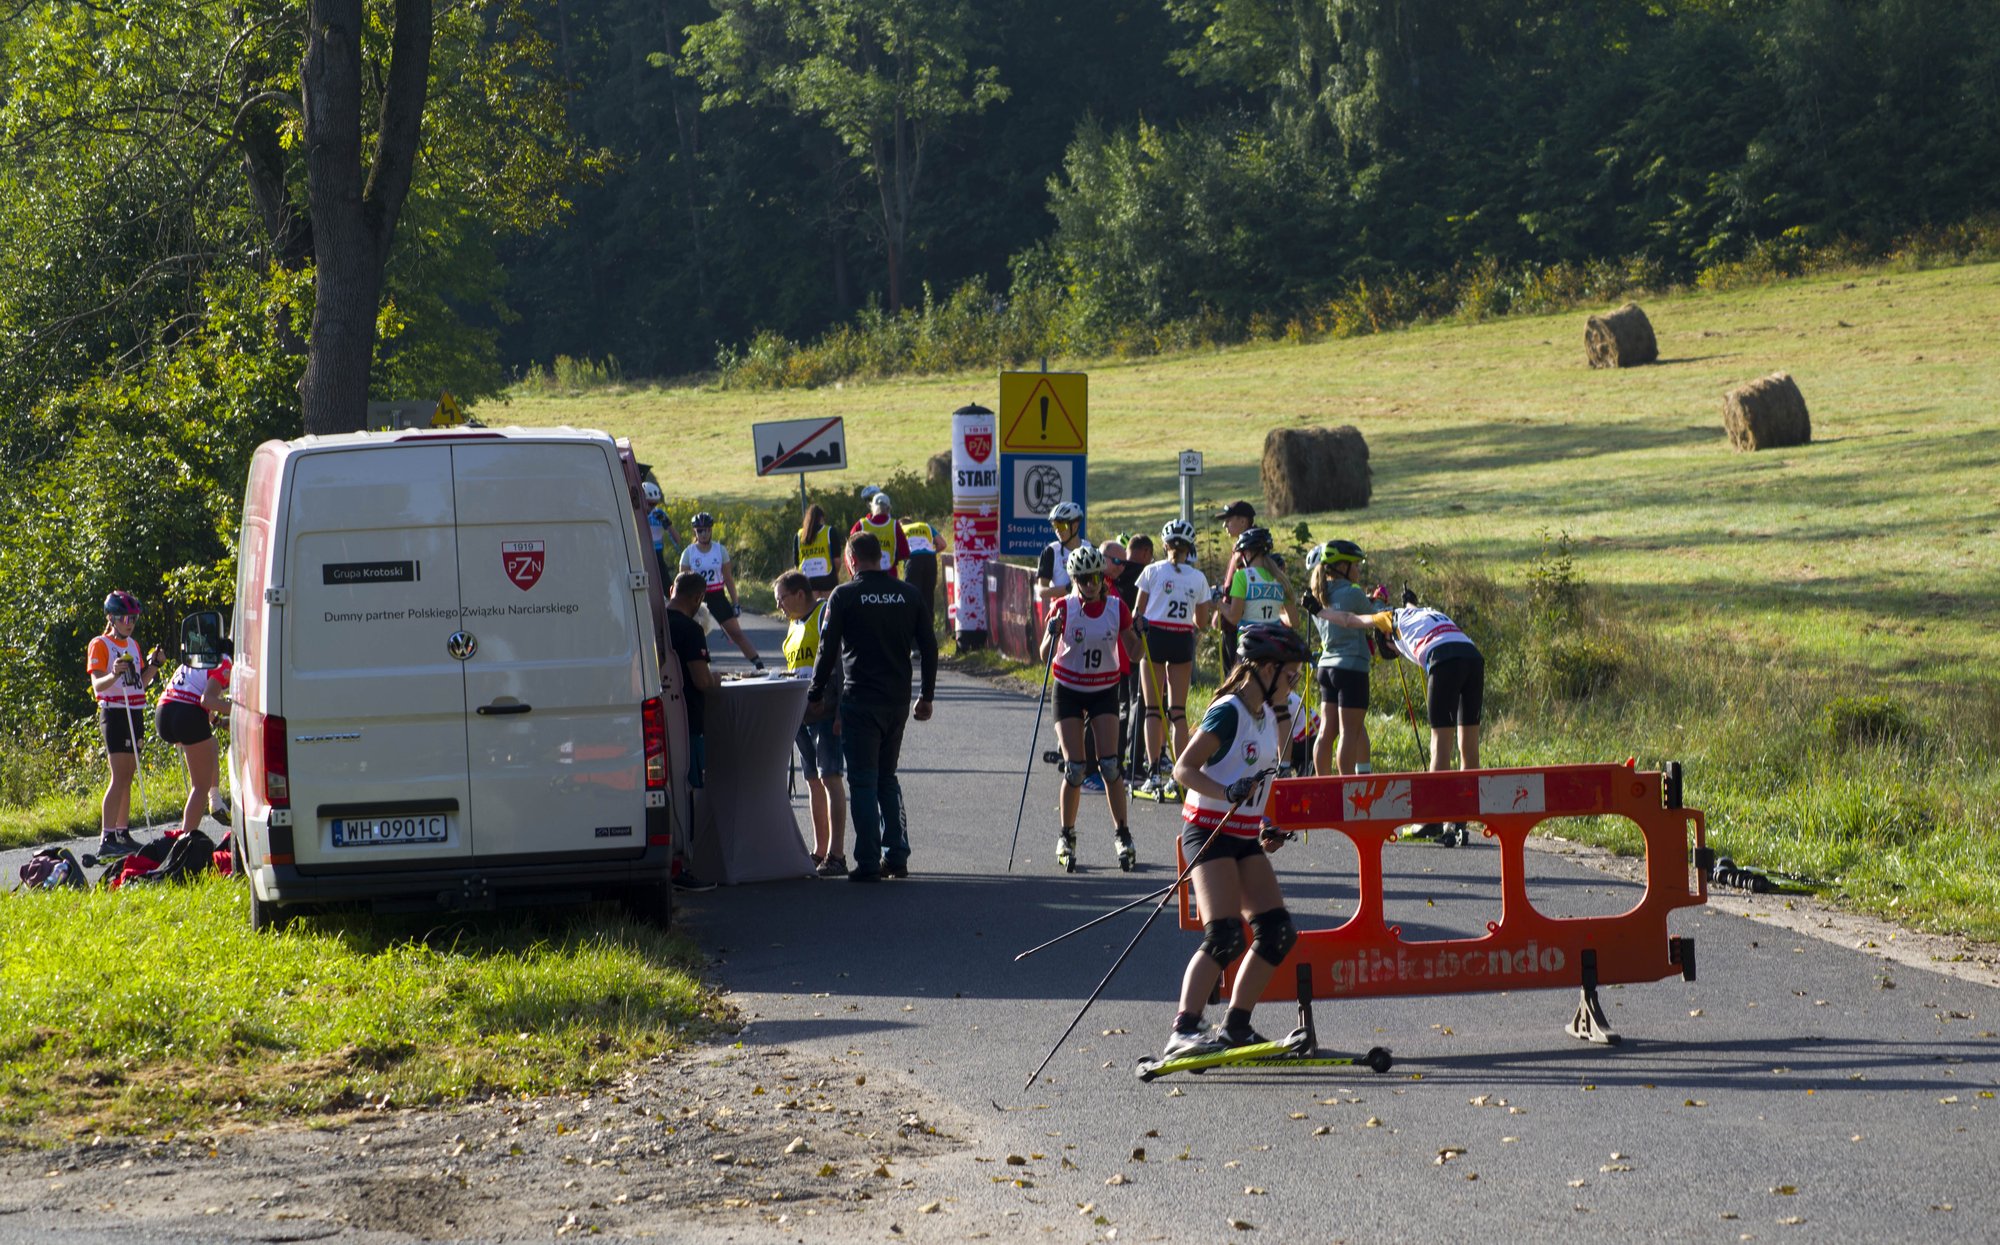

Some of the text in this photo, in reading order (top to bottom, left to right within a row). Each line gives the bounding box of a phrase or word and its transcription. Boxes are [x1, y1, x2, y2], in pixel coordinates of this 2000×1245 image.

[969, 437, 990, 456] PZN
[958, 470, 996, 487] START
[1007, 523, 1036, 535] Stosuj
[513, 543, 534, 551] 1919
[334, 567, 403, 579] Grupa Krotoski
[508, 557, 542, 580] PZN
[861, 593, 906, 604] POLSKA
[1251, 585, 1284, 599] DZN
[324, 603, 579, 622] Dumny partner Polskiego Związku Narciarskiego
[1168, 600, 1188, 619] 25
[1261, 606, 1273, 619] 17
[1083, 648, 1102, 669] 19
[347, 818, 440, 840] WH 0901C
